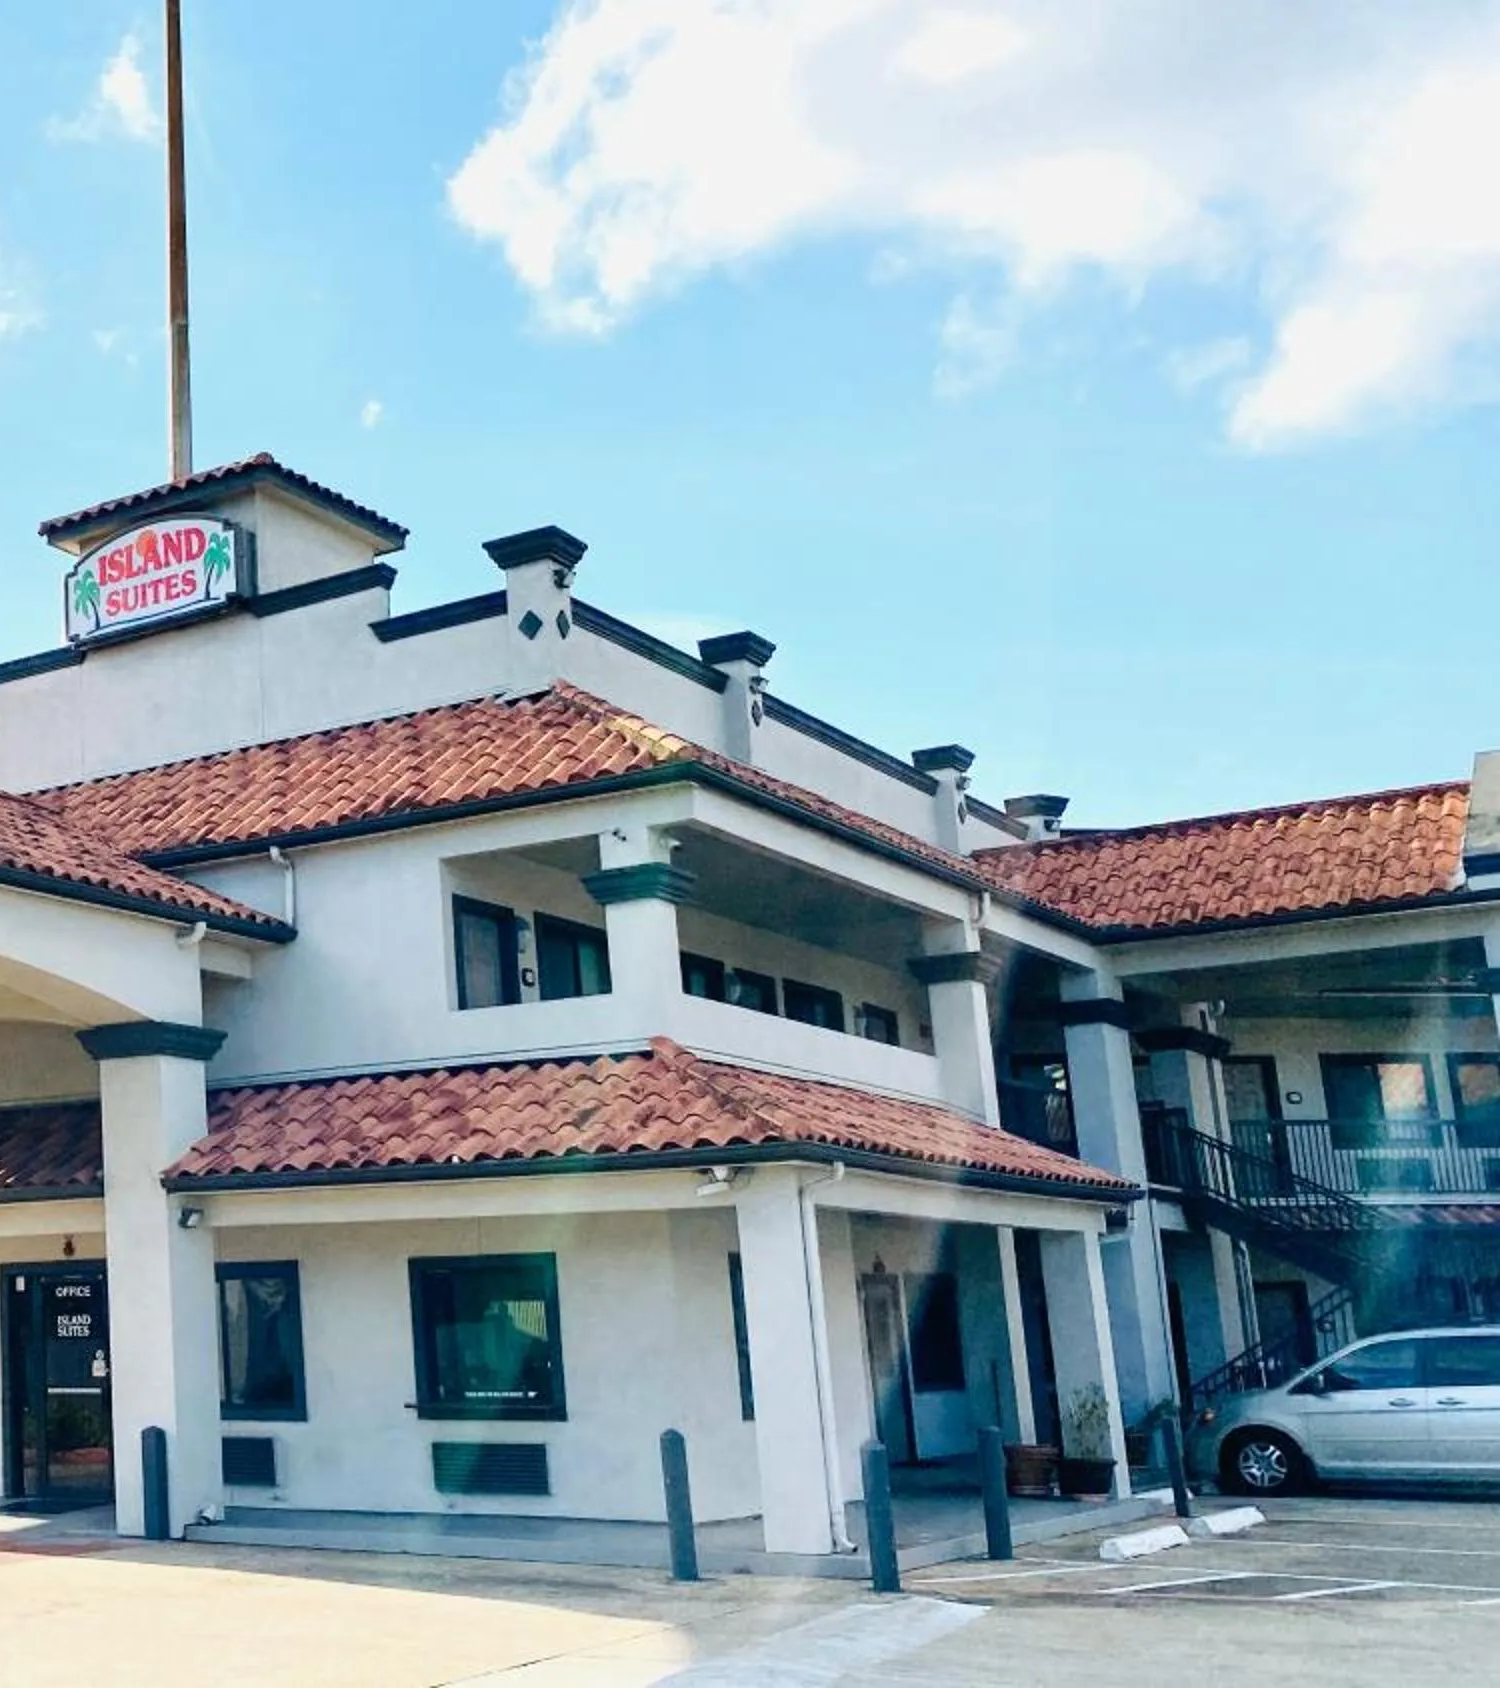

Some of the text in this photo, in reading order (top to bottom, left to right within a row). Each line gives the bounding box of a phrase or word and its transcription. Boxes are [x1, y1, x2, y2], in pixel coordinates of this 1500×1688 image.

[97, 527, 206, 587] ISLAND
[106, 569, 197, 617] SUITES
[55, 1285, 91, 1297] OFFICE
[57, 1314, 92, 1325] ISLAND
[57, 1325, 91, 1337] SUITES
